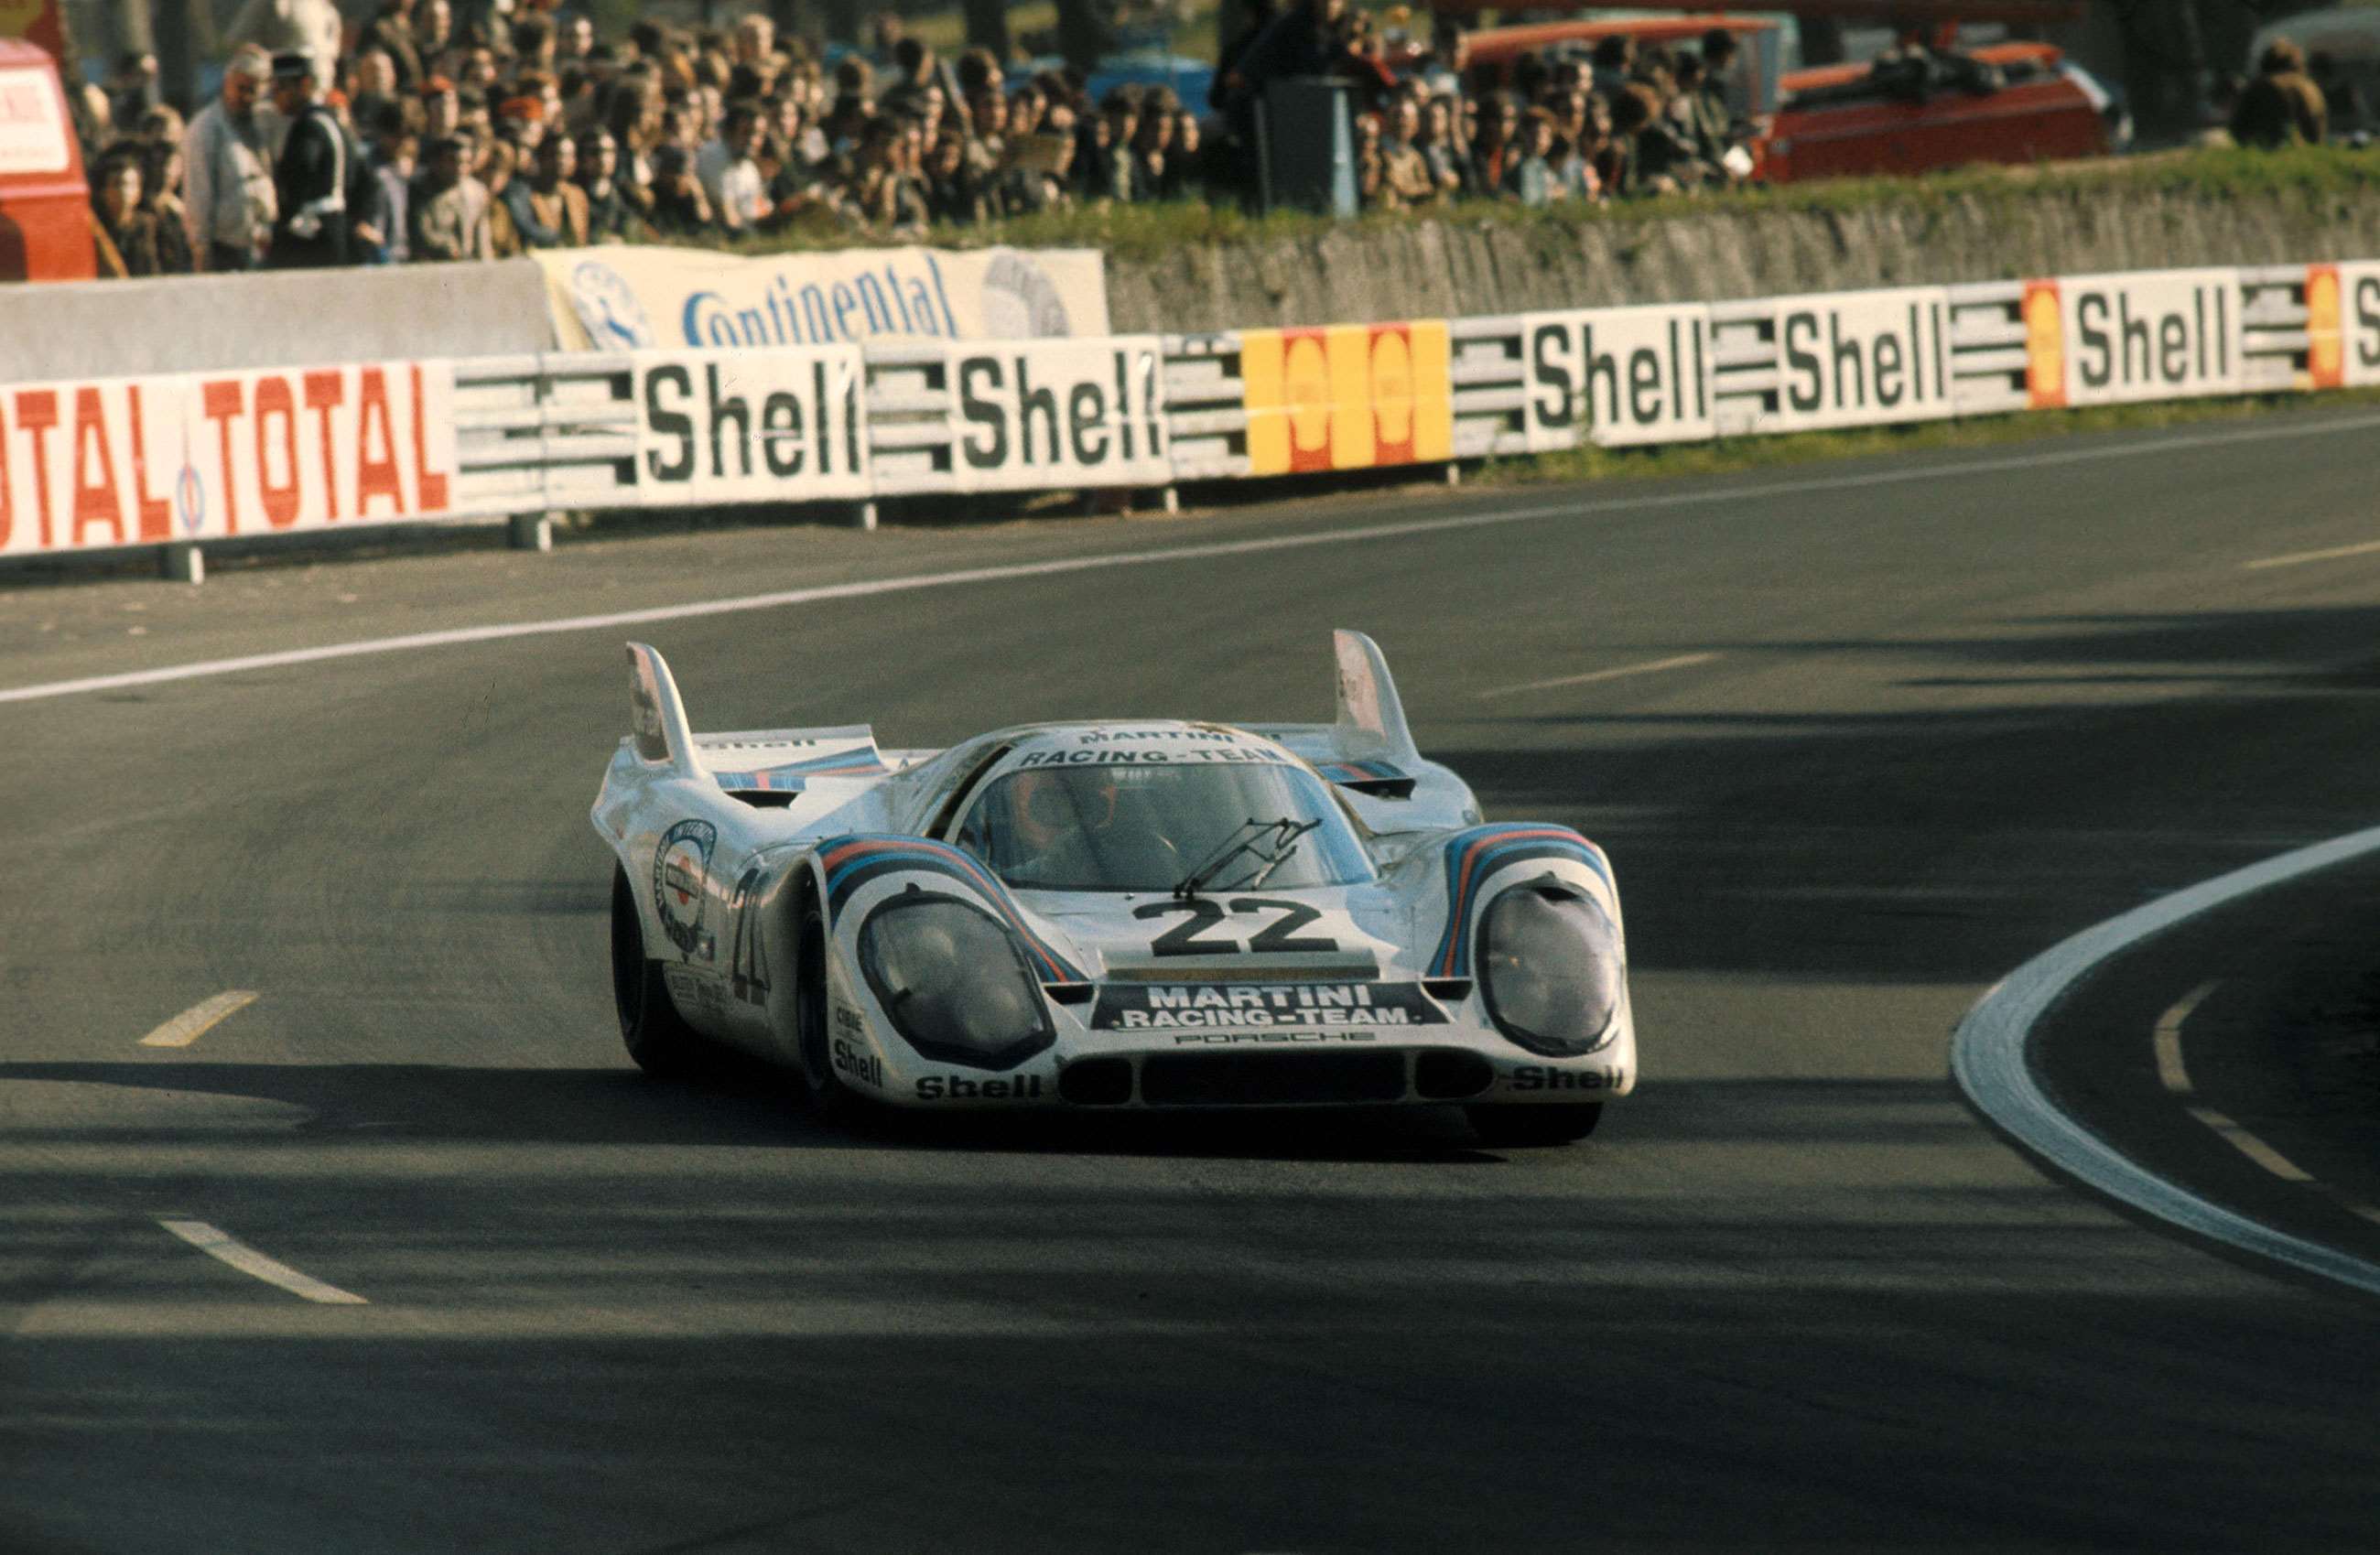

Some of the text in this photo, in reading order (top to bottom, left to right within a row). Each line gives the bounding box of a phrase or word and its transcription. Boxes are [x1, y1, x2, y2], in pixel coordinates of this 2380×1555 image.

[682, 254, 960, 348] Continental
[2078, 286, 2228, 389] Shell
[1533, 319, 1706, 429] Shell
[1785, 302, 1946, 412] Shell
[201, 363, 449, 535] TOTAL
[644, 362, 862, 483] Shell
[959, 351, 1162, 468] Shell
[1132, 897, 1340, 957] 22
[1147, 984, 1373, 1009] MARTINI
[1174, 1031, 1376, 1045] PORSCHE
[834, 1039, 883, 1088] Shell
[916, 1074, 1041, 1099] Shell
[1513, 1064, 1624, 1090] Shell
